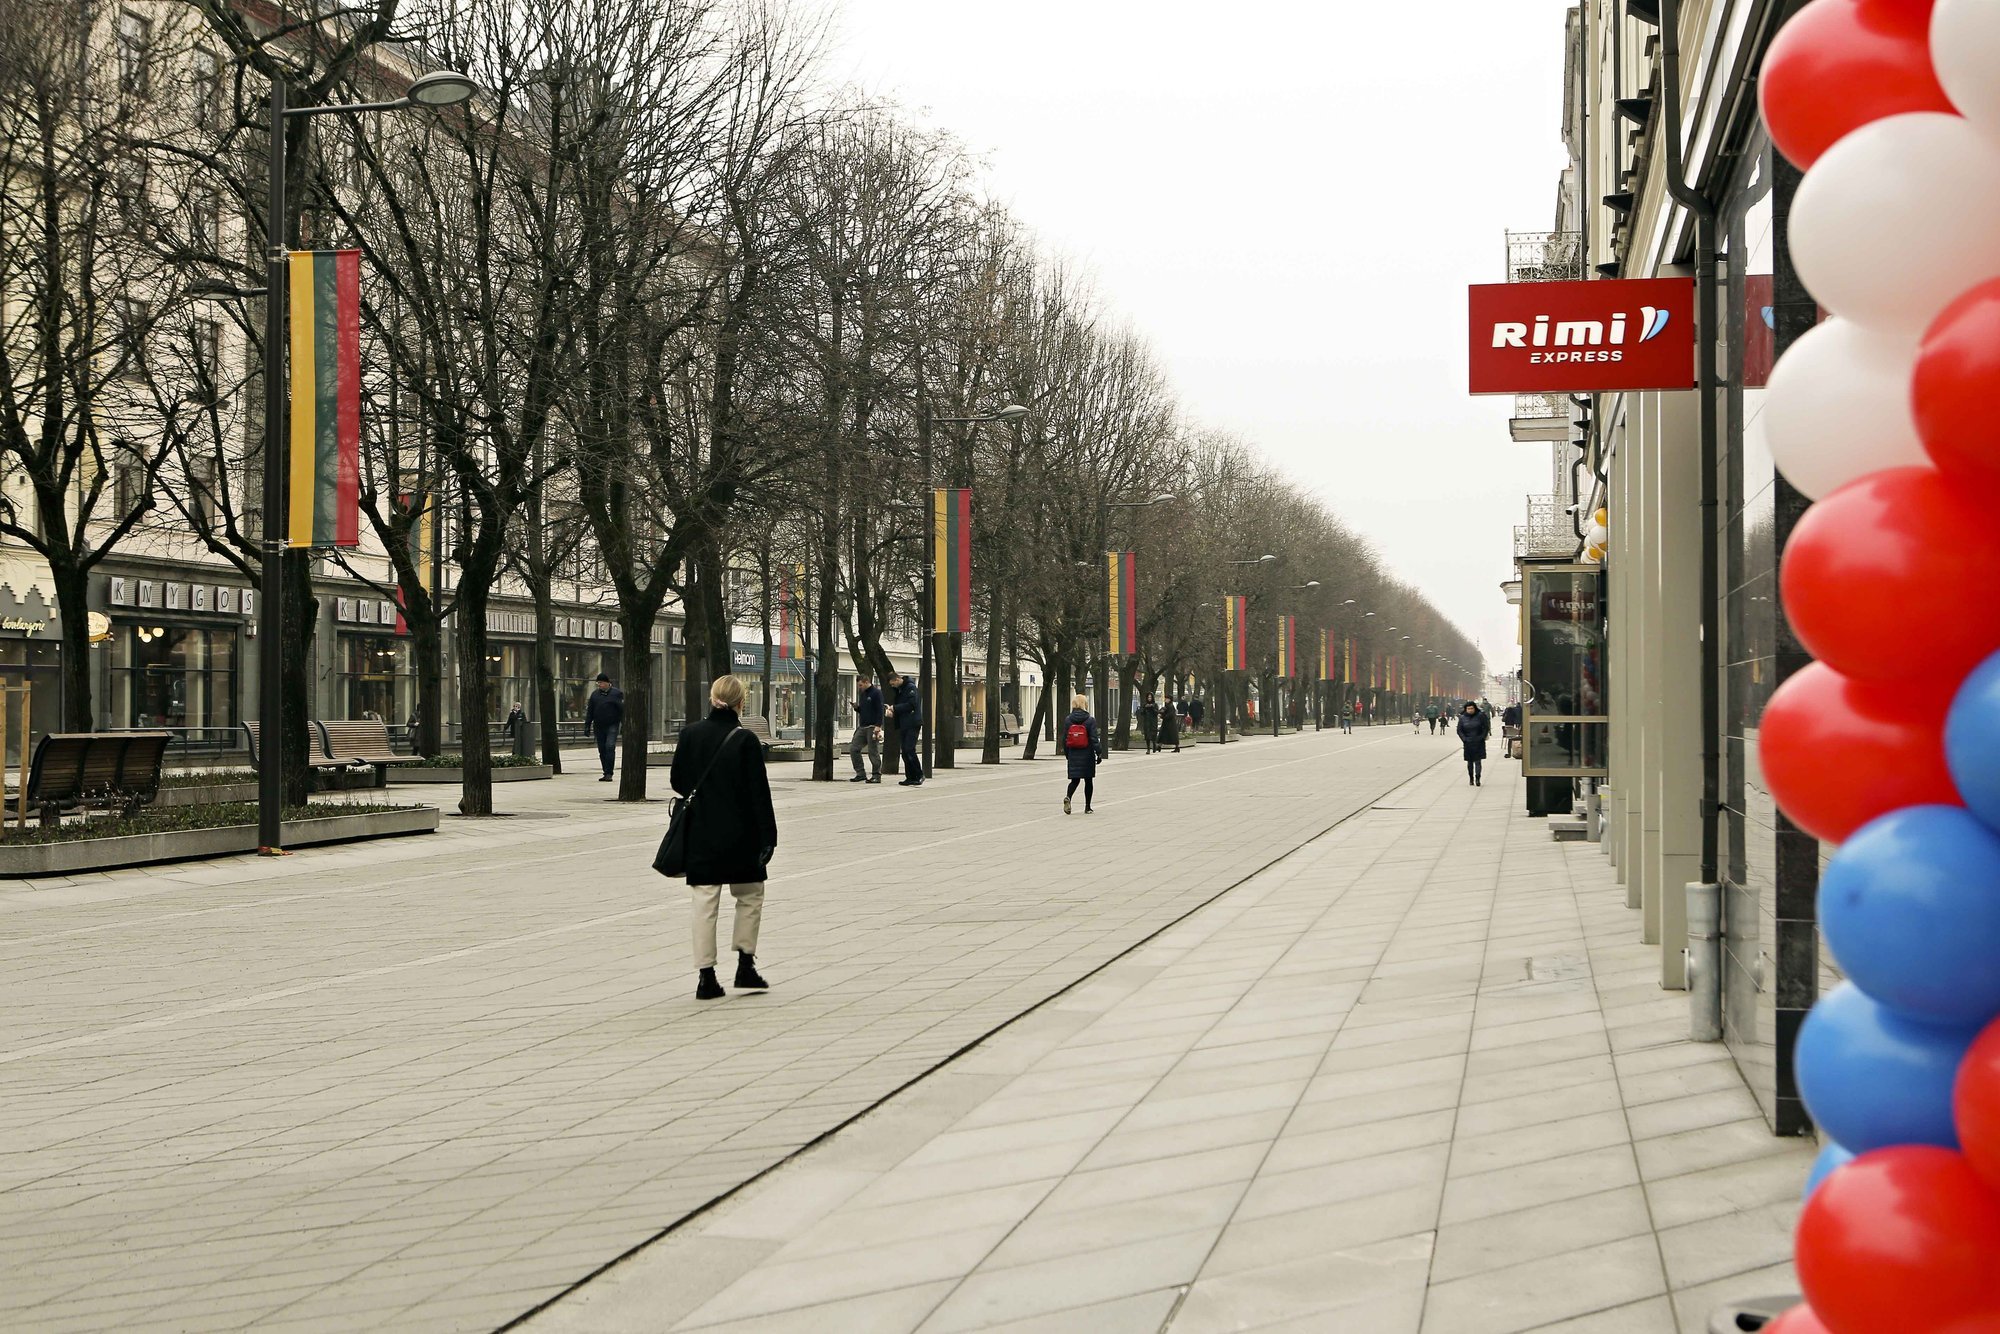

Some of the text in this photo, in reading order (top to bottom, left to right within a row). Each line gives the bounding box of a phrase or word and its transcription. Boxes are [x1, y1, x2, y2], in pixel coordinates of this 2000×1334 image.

[1491, 312, 1627, 348] Rimi
[1530, 350, 1623, 364] EXPRESS
[114, 582, 253, 611] KNYGOS
[555, 618, 619, 638] KNYGO
